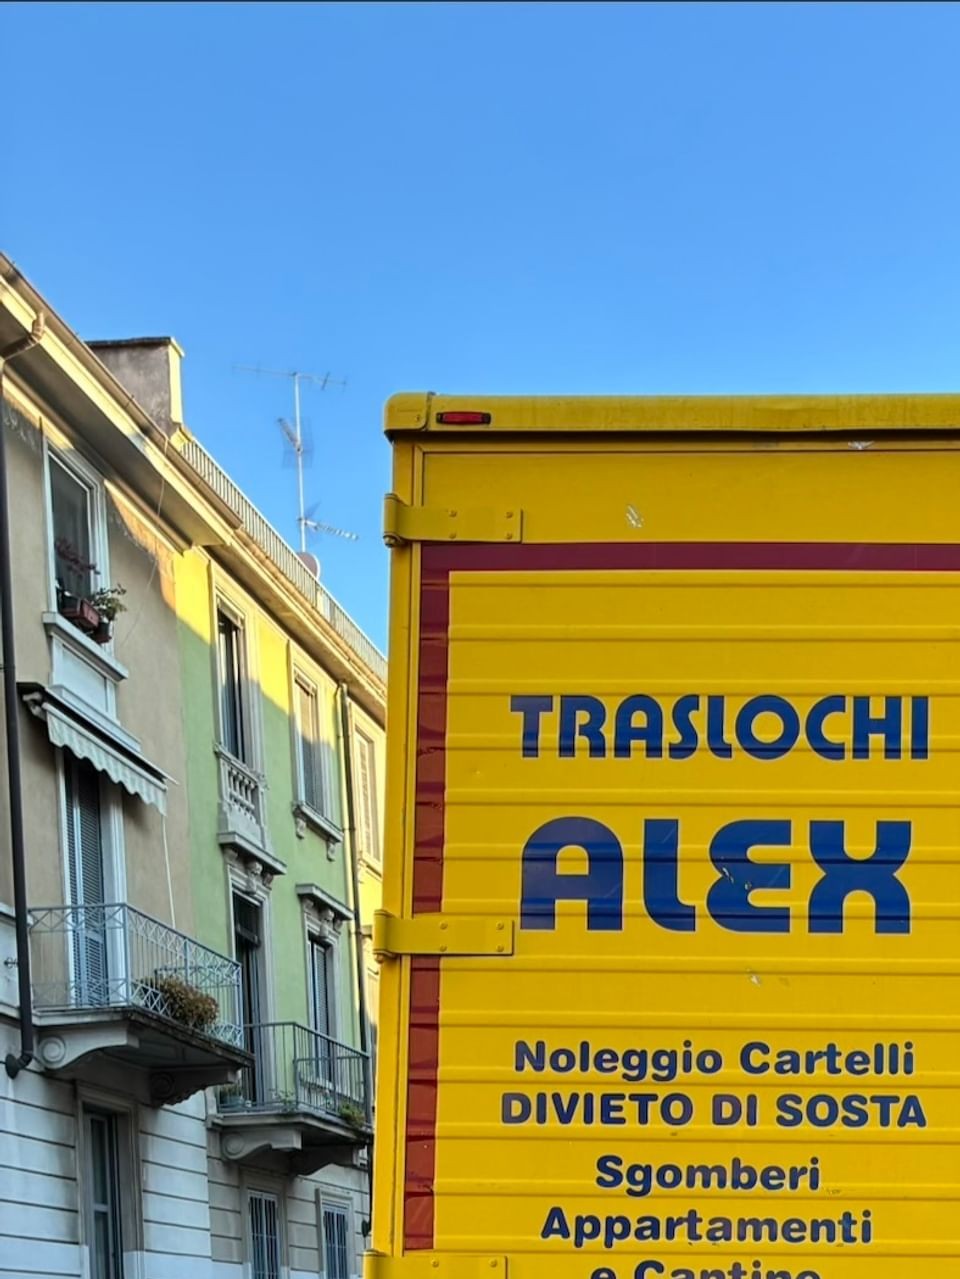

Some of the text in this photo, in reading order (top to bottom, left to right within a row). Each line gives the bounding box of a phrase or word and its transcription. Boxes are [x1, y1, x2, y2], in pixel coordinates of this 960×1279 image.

[511, 694, 929, 761] TRASLOCHI
[520, 816, 912, 934] ALEX
[514, 1041, 915, 1082] Noleggio Cartelli
[502, 1093, 927, 1128] DIVIETO DI SOSTA
[596, 1154, 821, 1196] Sgomberi
[540, 1207, 873, 1249] Appartamenti
